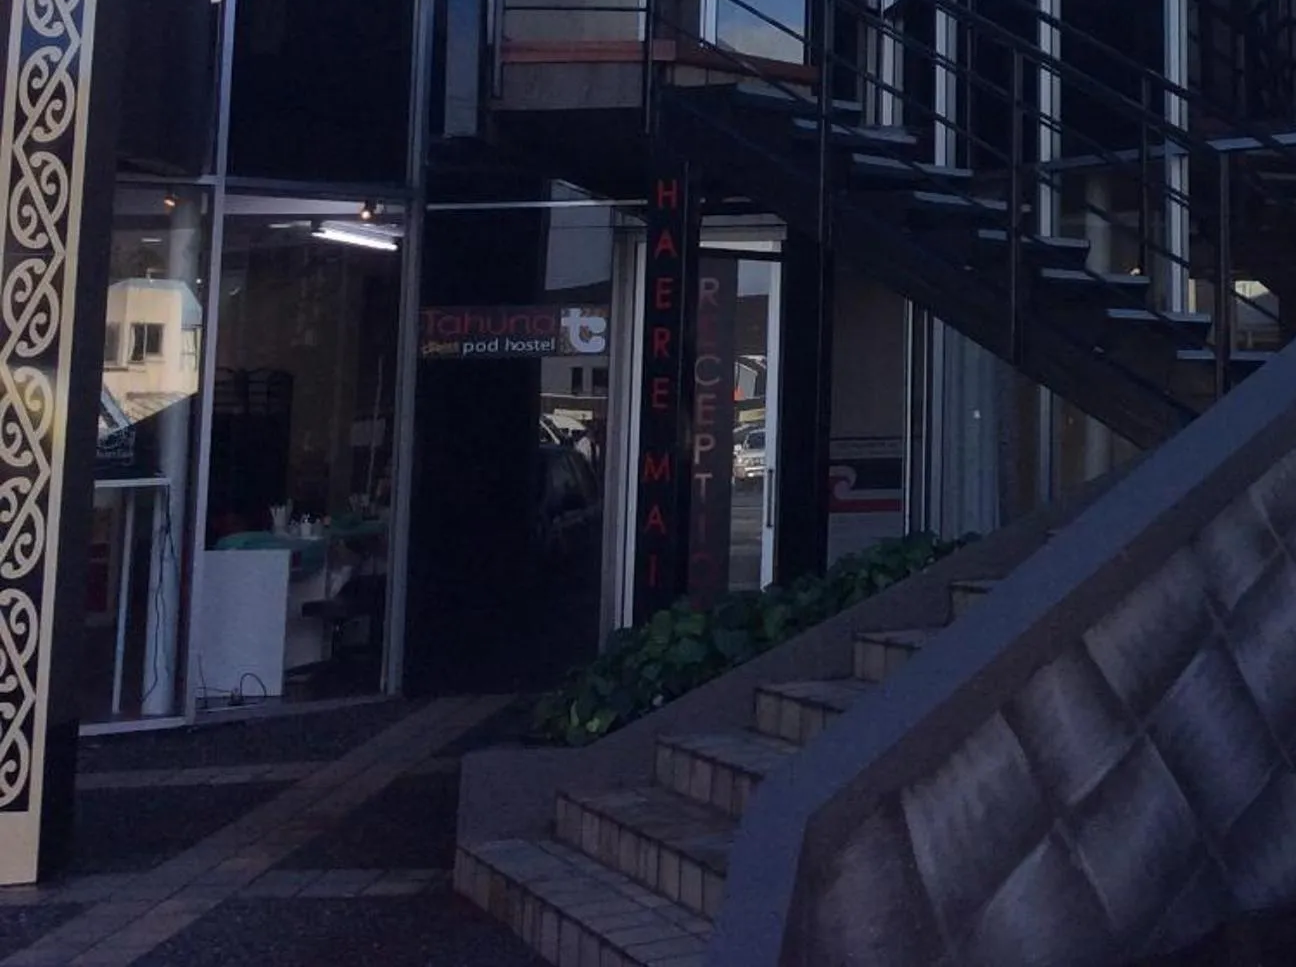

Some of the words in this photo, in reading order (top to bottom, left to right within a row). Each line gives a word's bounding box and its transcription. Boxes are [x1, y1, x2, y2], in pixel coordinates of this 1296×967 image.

[421, 308, 556, 335] Tahuna
[651, 179, 678, 410] HAERE
[462, 338, 499, 356] pod
[504, 336, 556, 352] hostel
[643, 451, 672, 587] MAI
